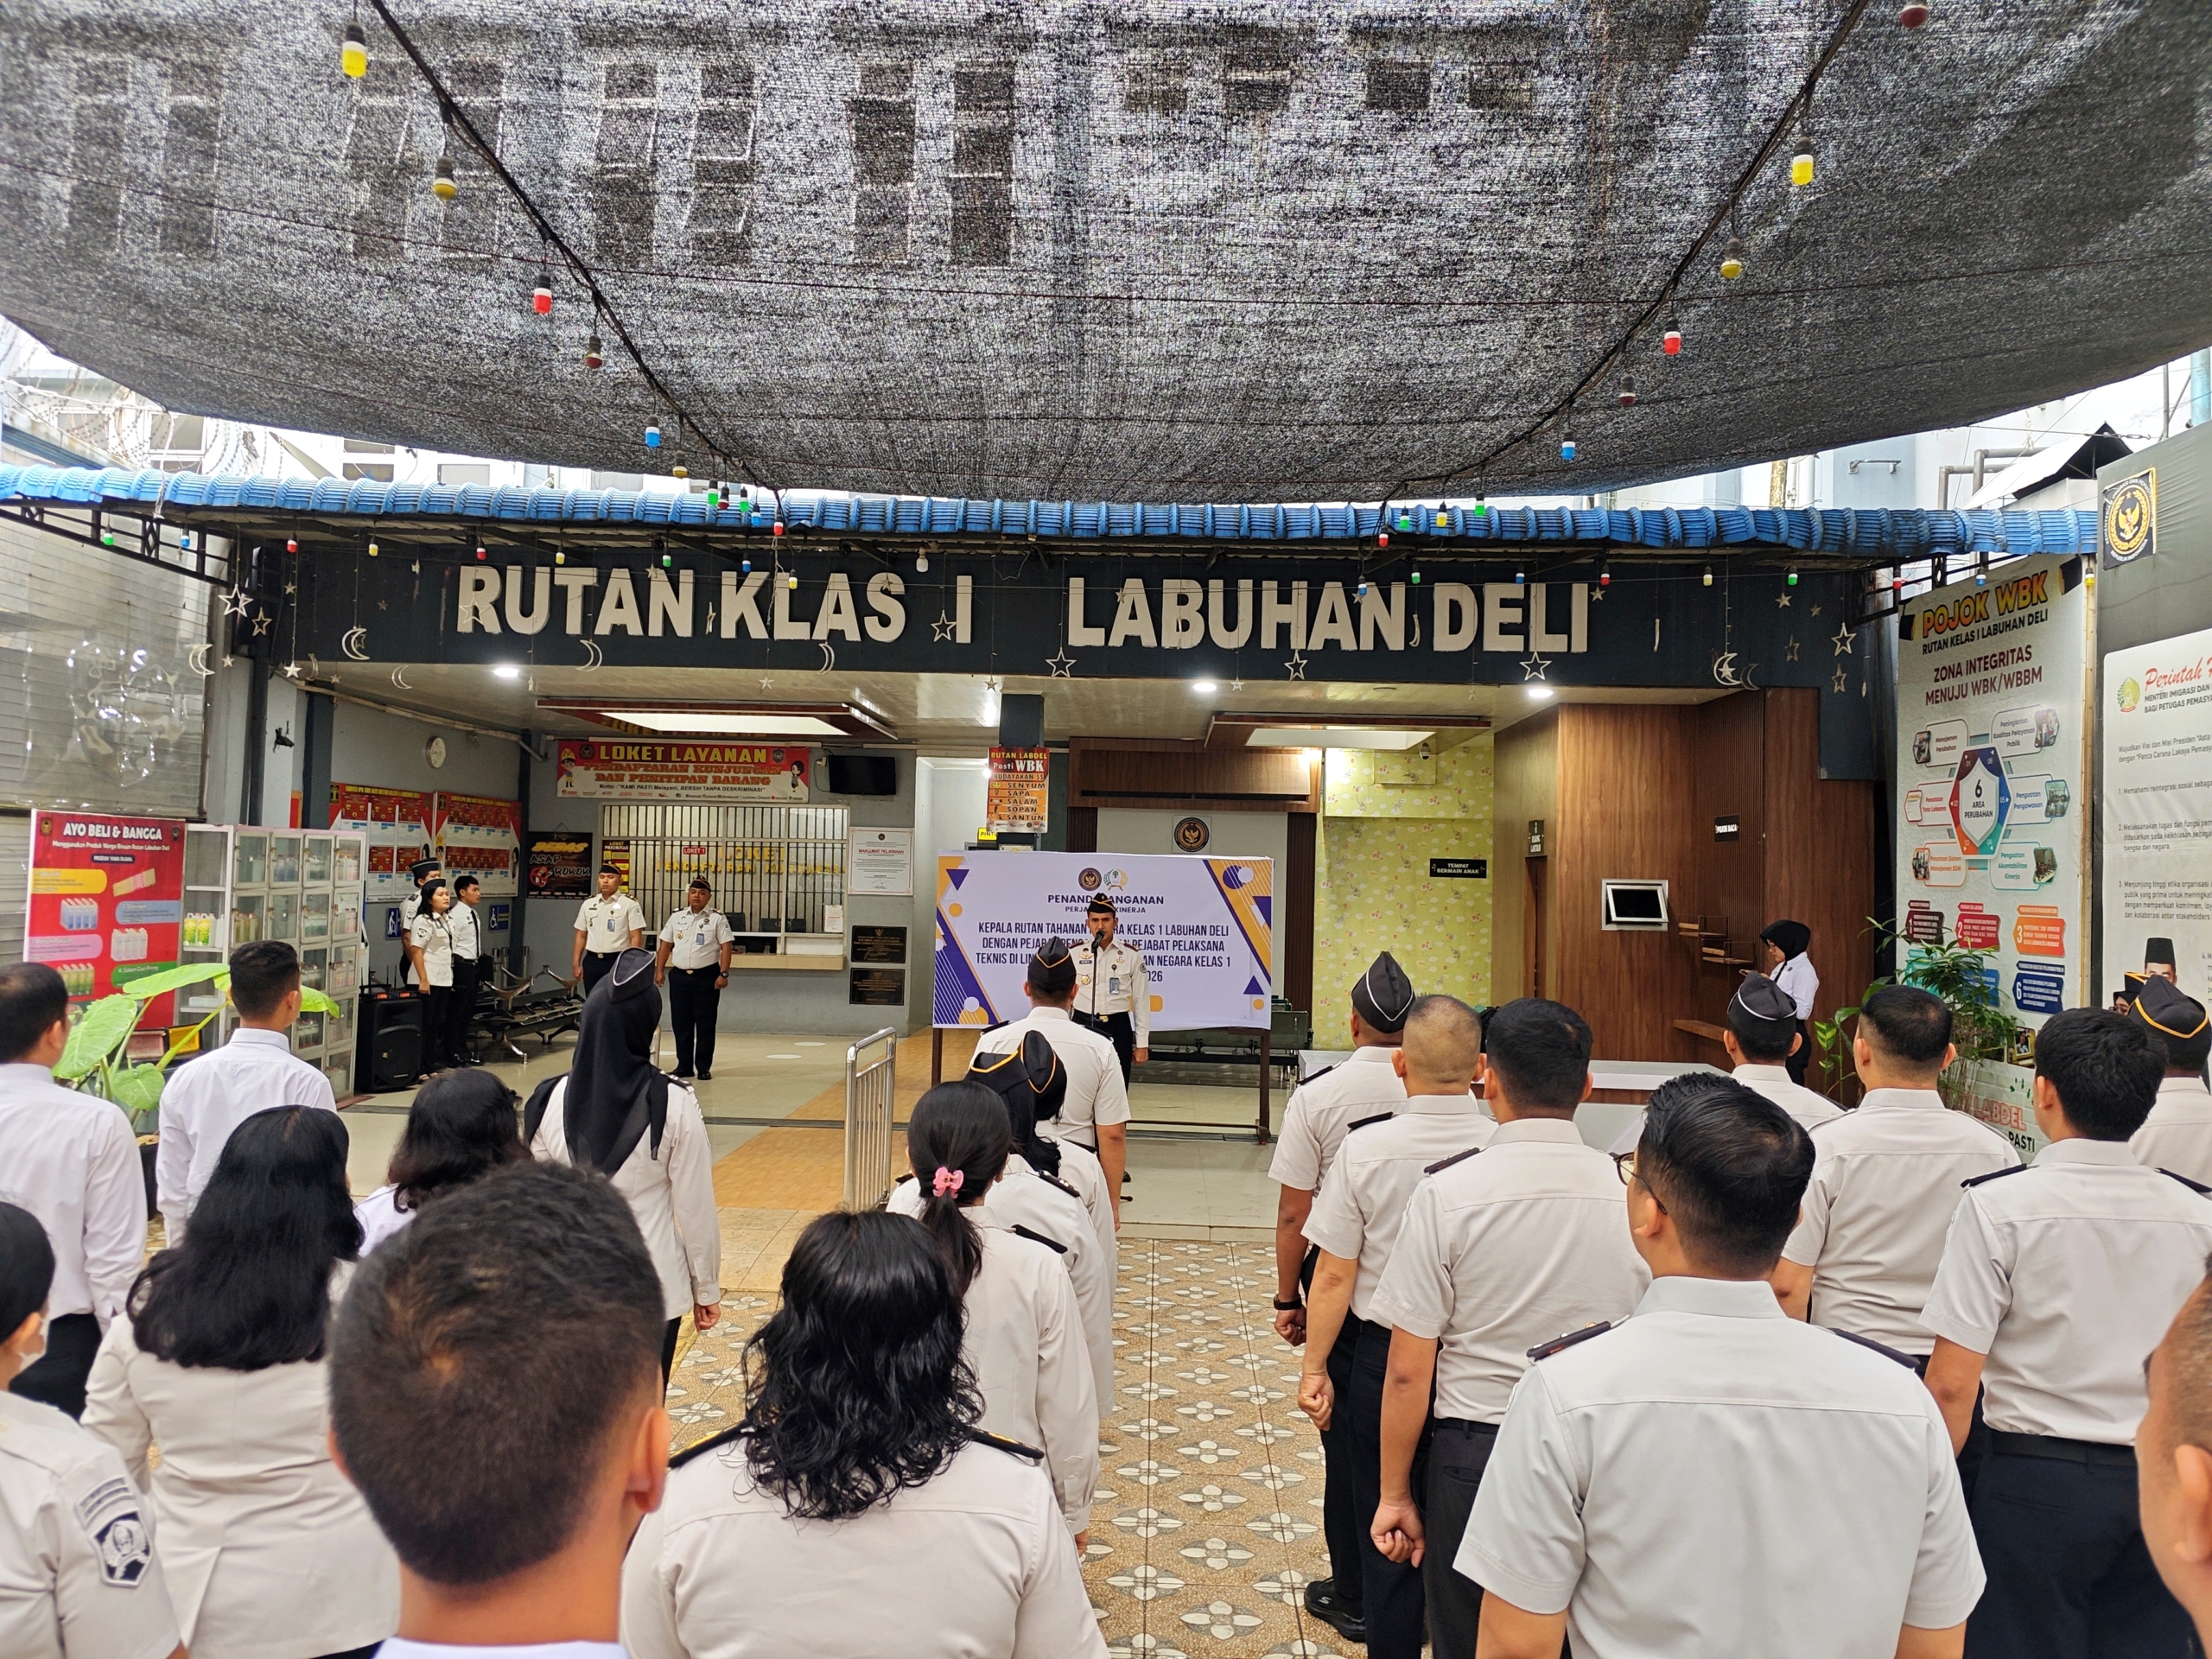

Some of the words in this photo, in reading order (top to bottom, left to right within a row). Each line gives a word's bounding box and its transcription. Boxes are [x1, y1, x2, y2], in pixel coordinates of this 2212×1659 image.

[456, 565, 694, 637] RUTAN
[720, 571, 906, 643] KLAS
[956, 575, 973, 644] I
[1067, 576, 1406, 652] LABUHAN
[1433, 582, 1589, 653] DELI
[1923, 590, 1990, 639] POJOK
[1995, 569, 2048, 616] WBK
[1923, 638, 1948, 655] RUTAN
[1950, 630, 1975, 648] KELAS
[1981, 615, 2024, 639] LABUHAN
[2027, 608, 2049, 626] DELI
[1934, 662, 1963, 683] ZONA
[1966, 645, 2032, 676] INTEGRITAS
[2145, 657, 2203, 692] Perintah
[1925, 683, 1968, 706] MENUJU
[1971, 665, 2043, 696] WBK/WBBM
[2145, 691, 2168, 702] MENTERI
[2169, 686, 2196, 698] IMIGRASI
[2196, 683, 2210, 693] DAN
[2145, 705, 2158, 714] BAGI
[2158, 700, 2184, 710] PETUGAS
[2173, 736, 2196, 745] Presiden
[601, 745, 664, 761] LOKET
[671, 747, 766, 763] LAYANAN
[584, 762, 690, 772] PENDAFTARAN
[693, 765, 782, 775] KUNJUNGAN
[1015, 760, 1044, 772] WBK
[595, 773, 626, 782] DAN
[712, 776, 771, 785] BARANG
[1975, 779, 1982, 798] 6
[63, 823, 86, 836] AYO
[88, 823, 111, 838] BELI
[112, 826, 121, 838] &
[123, 826, 162, 840] BANGGA
[530, 855, 562, 864] ASAP
[657, 861, 756, 873] ENDAFTARAN
[554, 867, 591, 876] ROKOK
[1048, 894, 1164, 904] PENANDANGANAN
[979, 922, 1012, 933] KEPALA
[1015, 923, 1043, 933] RUTAN
[1046, 923, 1087, 934] TAHANAN
[1128, 924, 1155, 935] KELAS
[1159, 925, 1162, 935] 1
[1166, 925, 1206, 936] LABUHAN
[1210, 925, 1229, 937] DELI
[982, 938, 1018, 949] DENGAN
[1020, 938, 1049, 950] PEJAB
[1132, 940, 1170, 950] PEJABAT
[1173, 940, 1224, 951] PELAKSANA
[976, 952, 1007, 964] TEKNIS
[1009, 953, 1018, 964] DI
[1157, 956, 1192, 967] NEGARA
[1195, 956, 1223, 967] KELAS
[1226, 957, 1230, 967] 1
[1147, 970, 1163, 982] 026
[2016, 982, 2022, 1000] 6
[1974, 1096, 2026, 1131] LABDEL
[2008, 1131, 2034, 1153] PASTI
